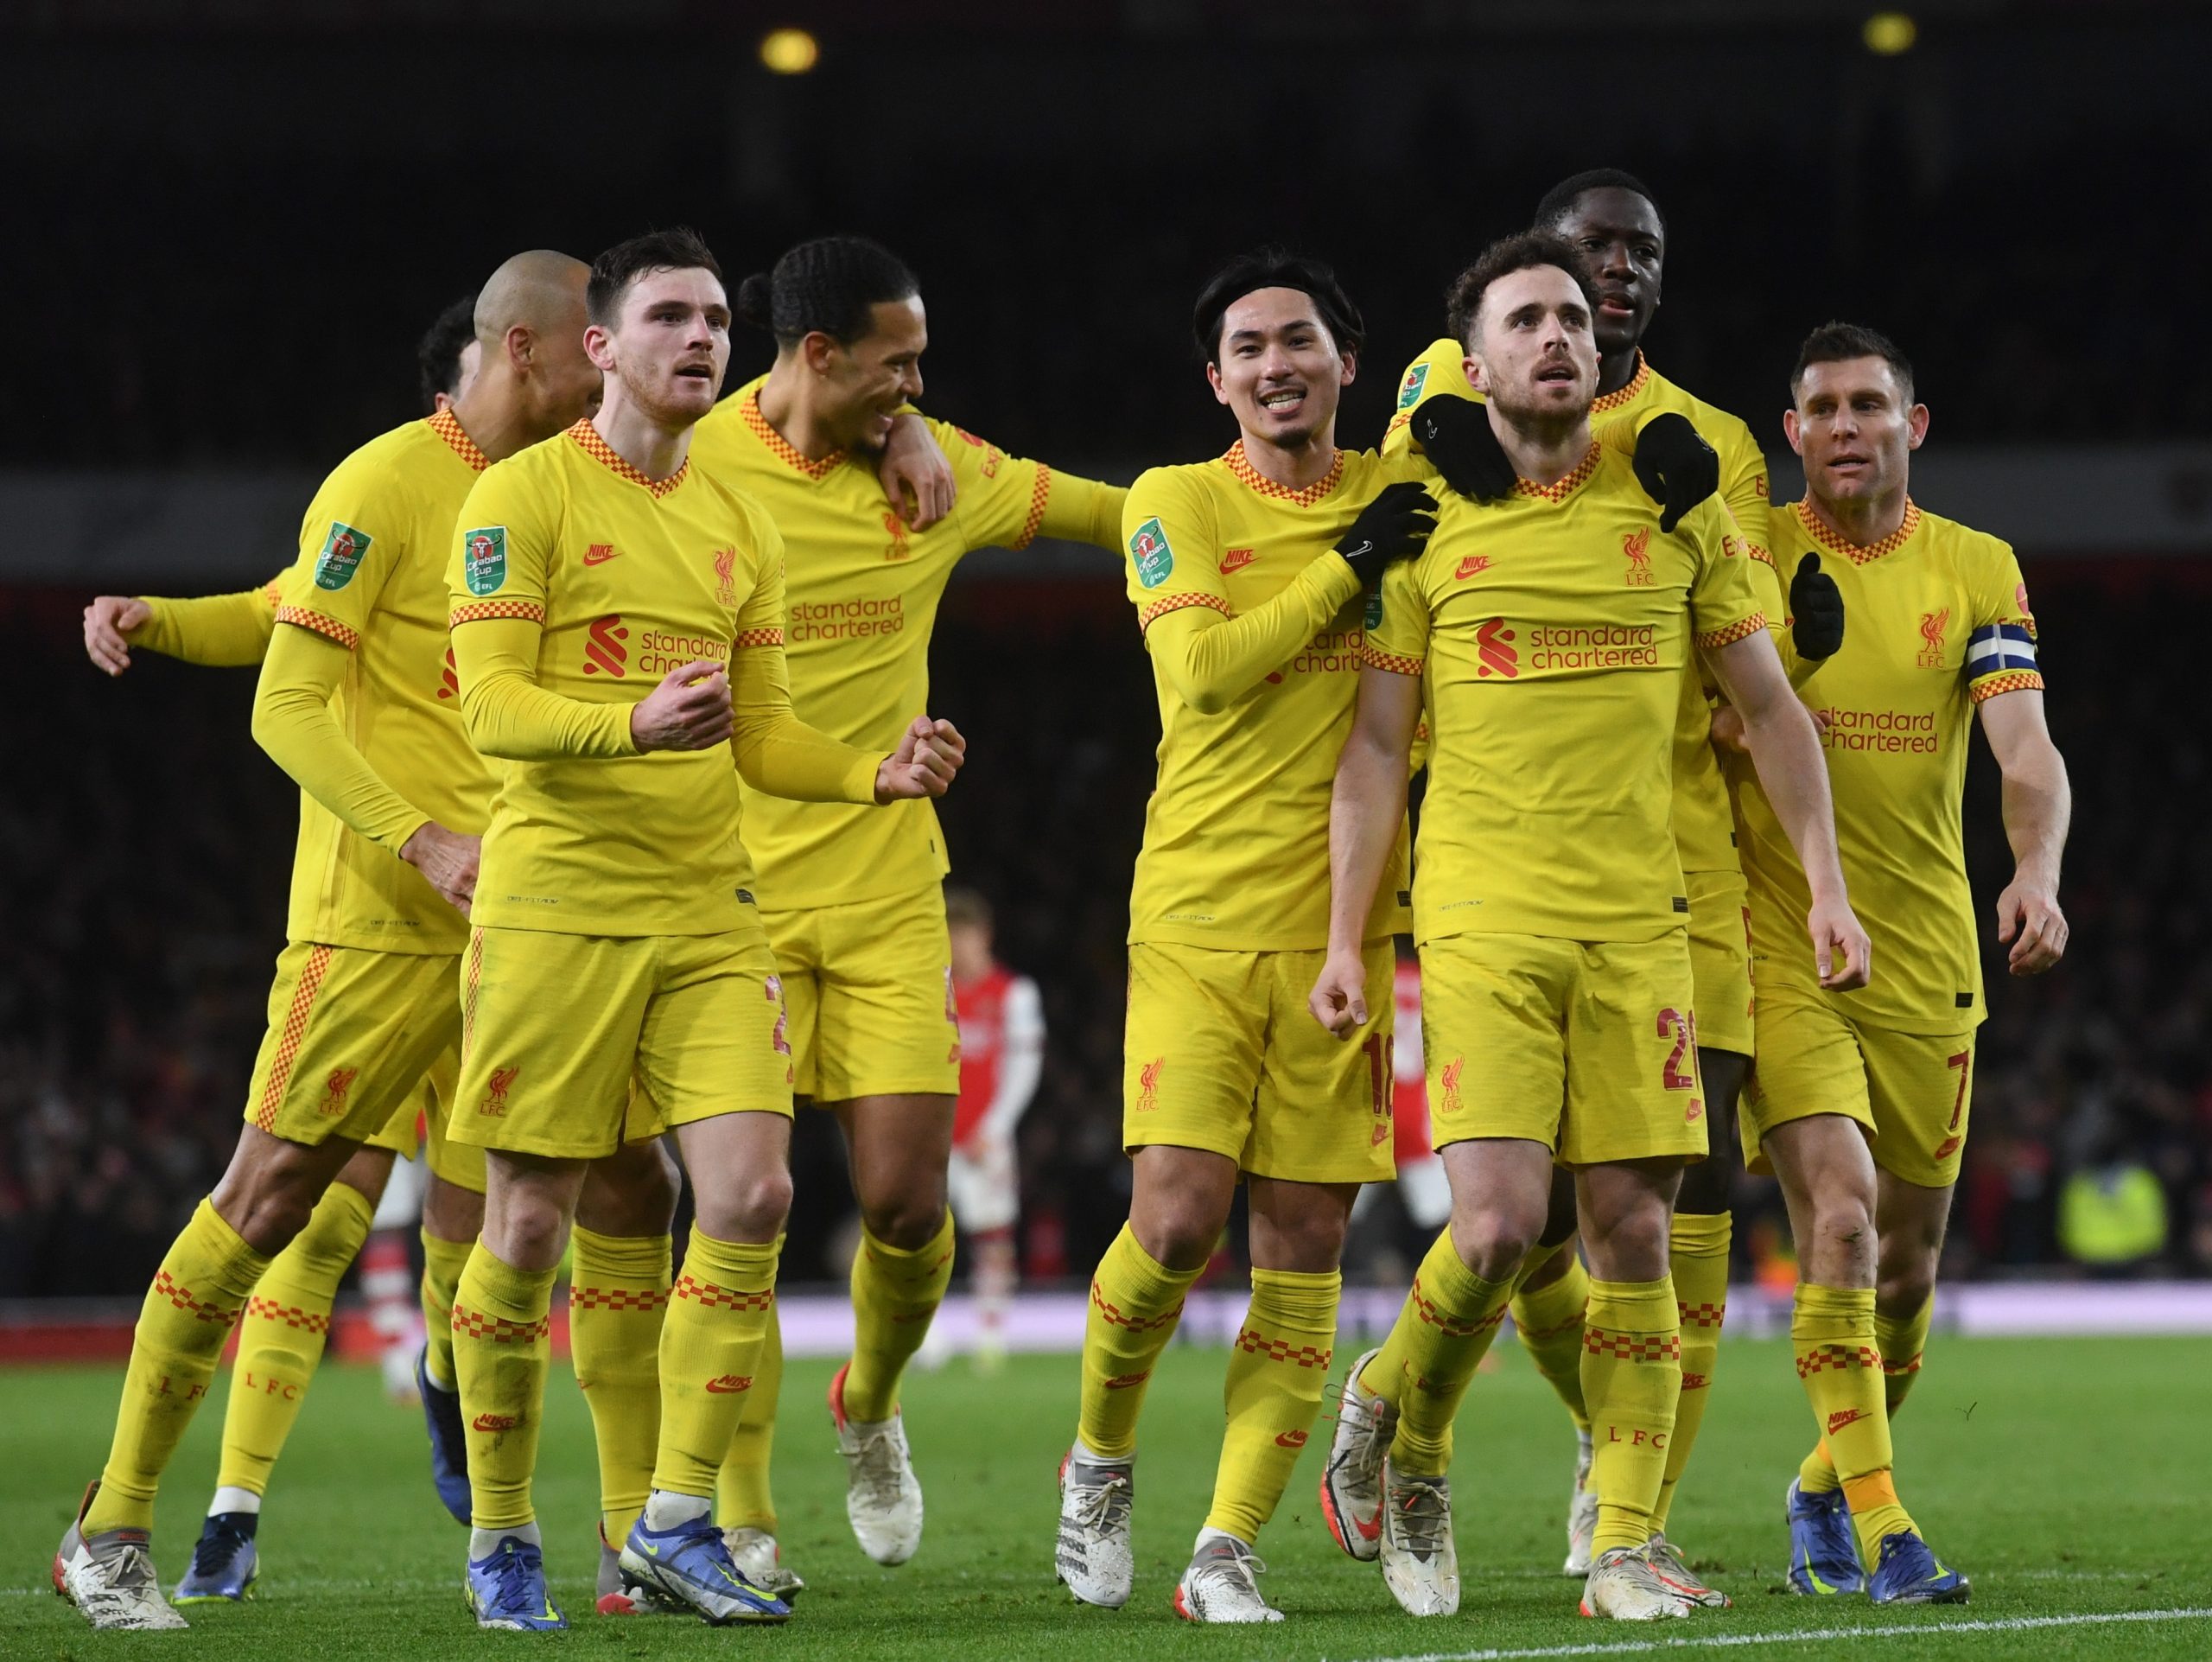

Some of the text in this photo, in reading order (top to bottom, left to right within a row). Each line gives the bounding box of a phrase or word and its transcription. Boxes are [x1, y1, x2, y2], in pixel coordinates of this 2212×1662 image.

[588, 544, 614, 558] NIKE
[1225, 549, 1254, 564] NIKE
[324, 560, 342, 571] Cup
[467, 554, 502, 571] Carabao
[1461, 556, 1490, 570] NIKE
[474, 566, 492, 576] Cup
[1626, 573, 1655, 586] LFC
[791, 595, 902, 621] standard
[791, 613, 904, 642] chartered
[1530, 624, 1654, 647] standard
[641, 629, 728, 661] standard
[1294, 650, 1361, 672] chart
[1531, 645, 1658, 669] chartered
[1917, 654, 1944, 669] LFC
[1948, 1050, 1969, 1131] 7
[480, 1102, 505, 1117] LFC
[1828, 1409, 1859, 1424] NIKE
[1609, 1426, 1667, 1449] LFC
